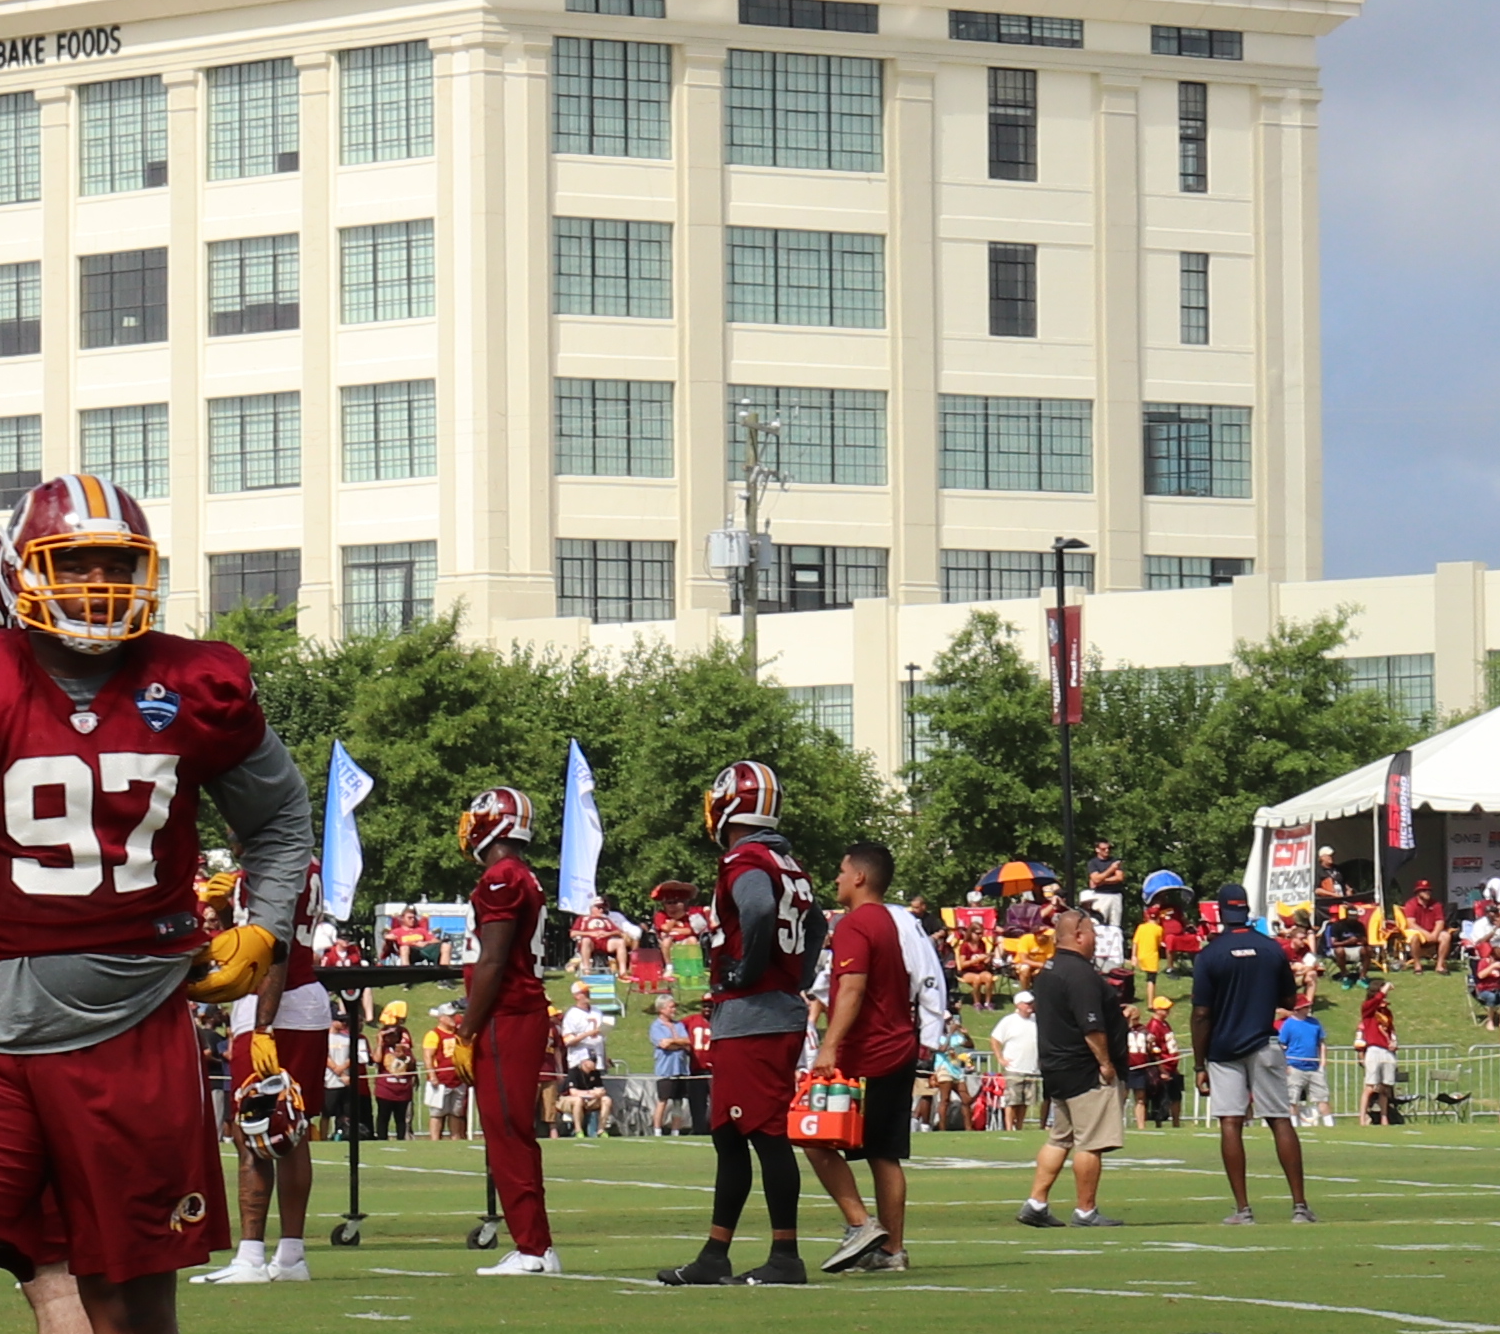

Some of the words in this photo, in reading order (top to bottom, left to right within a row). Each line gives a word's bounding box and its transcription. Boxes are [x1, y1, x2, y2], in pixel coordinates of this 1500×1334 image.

[56, 25, 122, 62] FOODS
[3, 752, 181, 896] 97
[799, 1115, 820, 1136] G
